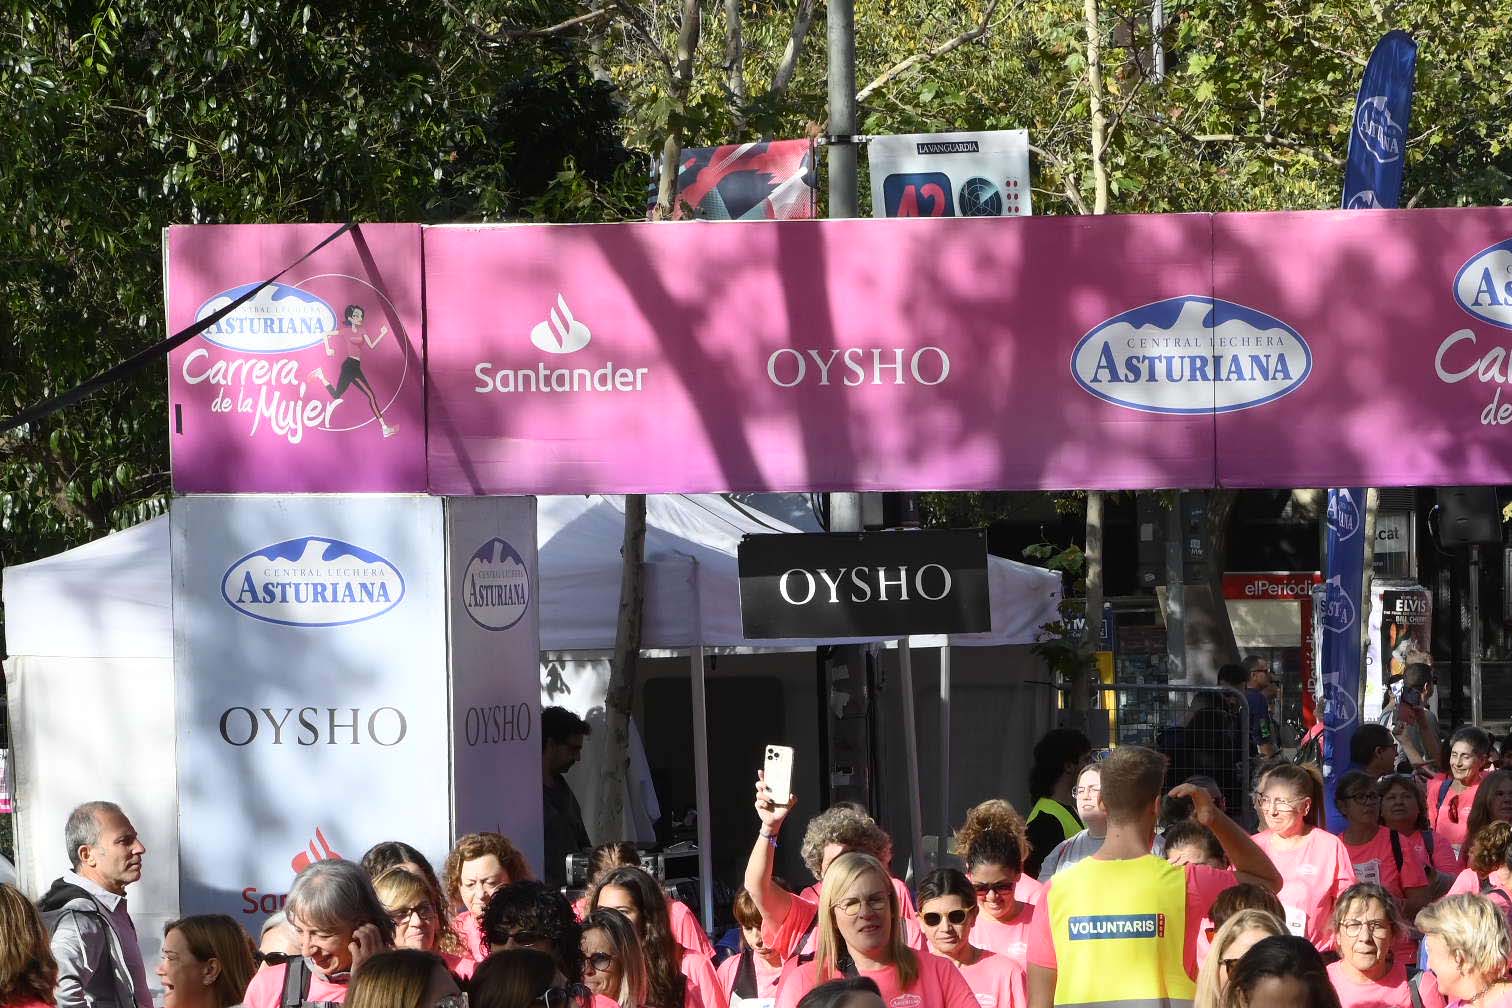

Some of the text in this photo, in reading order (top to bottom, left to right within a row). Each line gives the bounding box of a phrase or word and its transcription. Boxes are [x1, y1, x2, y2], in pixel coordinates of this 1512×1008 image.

[1126, 335, 1285, 348] CENTRAL LECHERA
[182, 348, 299, 386] Carrera
[473, 361, 648, 394] Santander
[766, 346, 951, 388] OYSHO
[1089, 340, 1293, 384] ASTURIANA
[211, 379, 344, 445] de la Mujer
[236, 570, 393, 604] ASTURIANA
[263, 567, 386, 577] CENTRAL LECHERA
[778, 563, 953, 605] OYSHO
[468, 573, 526, 609] ASTURIANA
[1395, 599, 1427, 612] ELVIS
[219, 705, 408, 746] OYSHO
[465, 702, 531, 746] OYSHO
[1069, 917, 1156, 936] VOLUNTARIS
